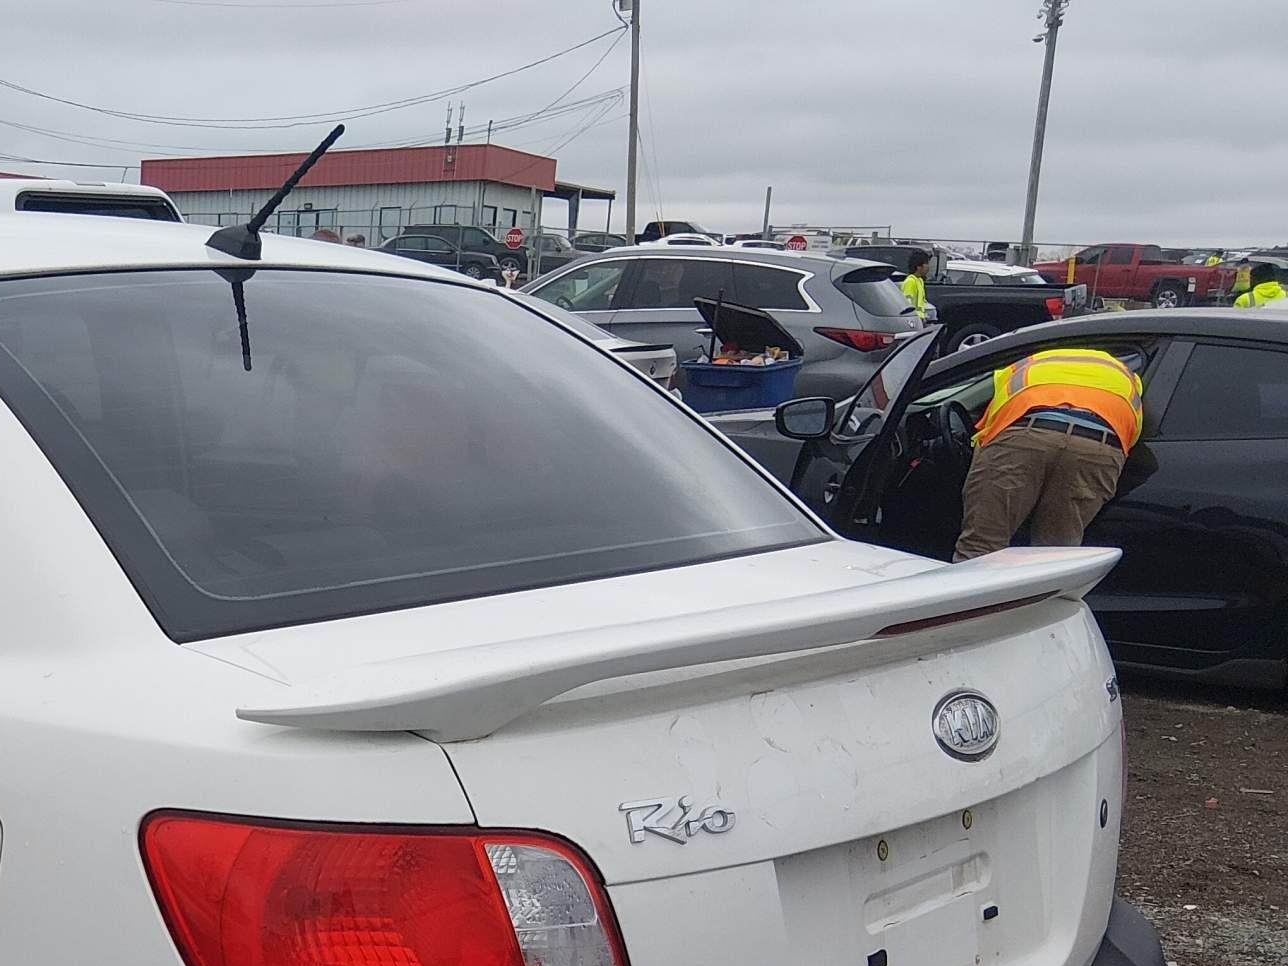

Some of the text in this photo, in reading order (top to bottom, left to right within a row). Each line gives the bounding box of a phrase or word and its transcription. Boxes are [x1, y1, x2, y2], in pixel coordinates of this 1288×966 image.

[787, 241, 807, 251] STOP
[943, 701, 994, 746] KIA
[618, 794, 737, 846] Rio
